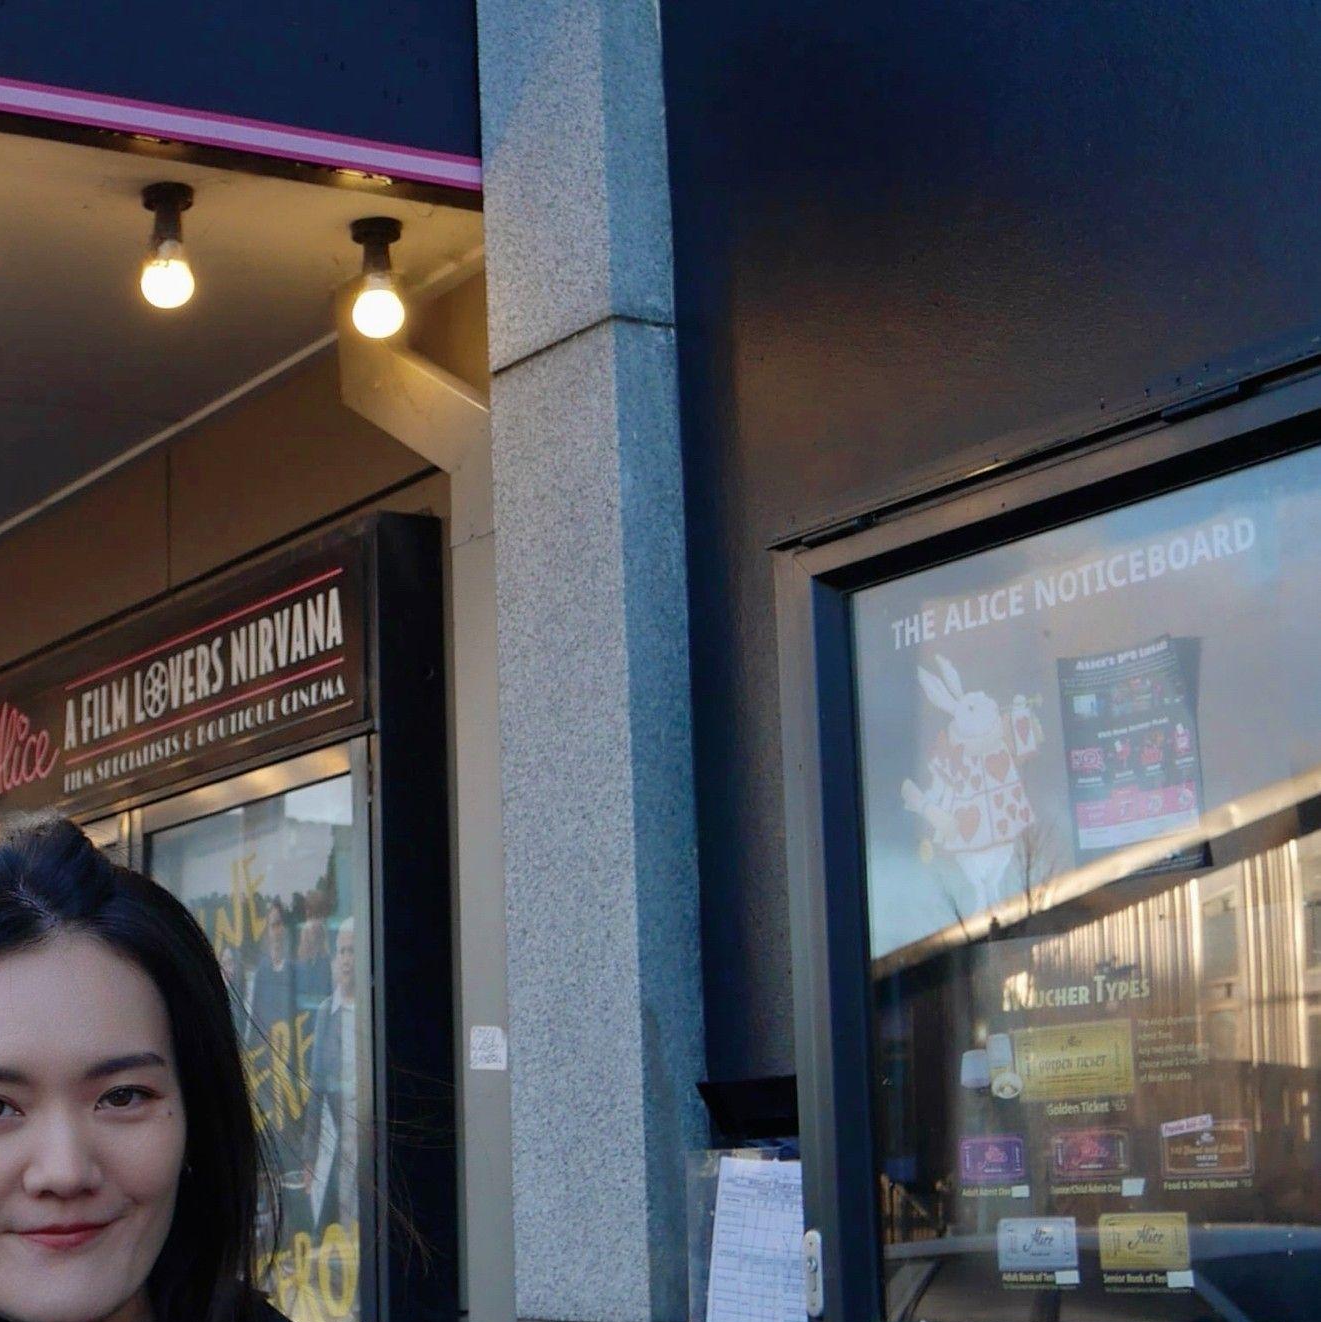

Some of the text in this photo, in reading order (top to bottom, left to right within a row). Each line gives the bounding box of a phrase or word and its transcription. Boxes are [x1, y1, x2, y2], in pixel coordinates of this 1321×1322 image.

[891, 517, 1257, 650] THE ALICE NOTICEBOARD
[64, 587, 343, 751] A FILM LOVERS NIRVANA
[96, 735, 180, 781] SPECIALISTS
[197, 698, 277, 746] BOUTIQUE
[280, 674, 346, 716] CINEMA
[1094, 974, 1150, 1003] TYPES
